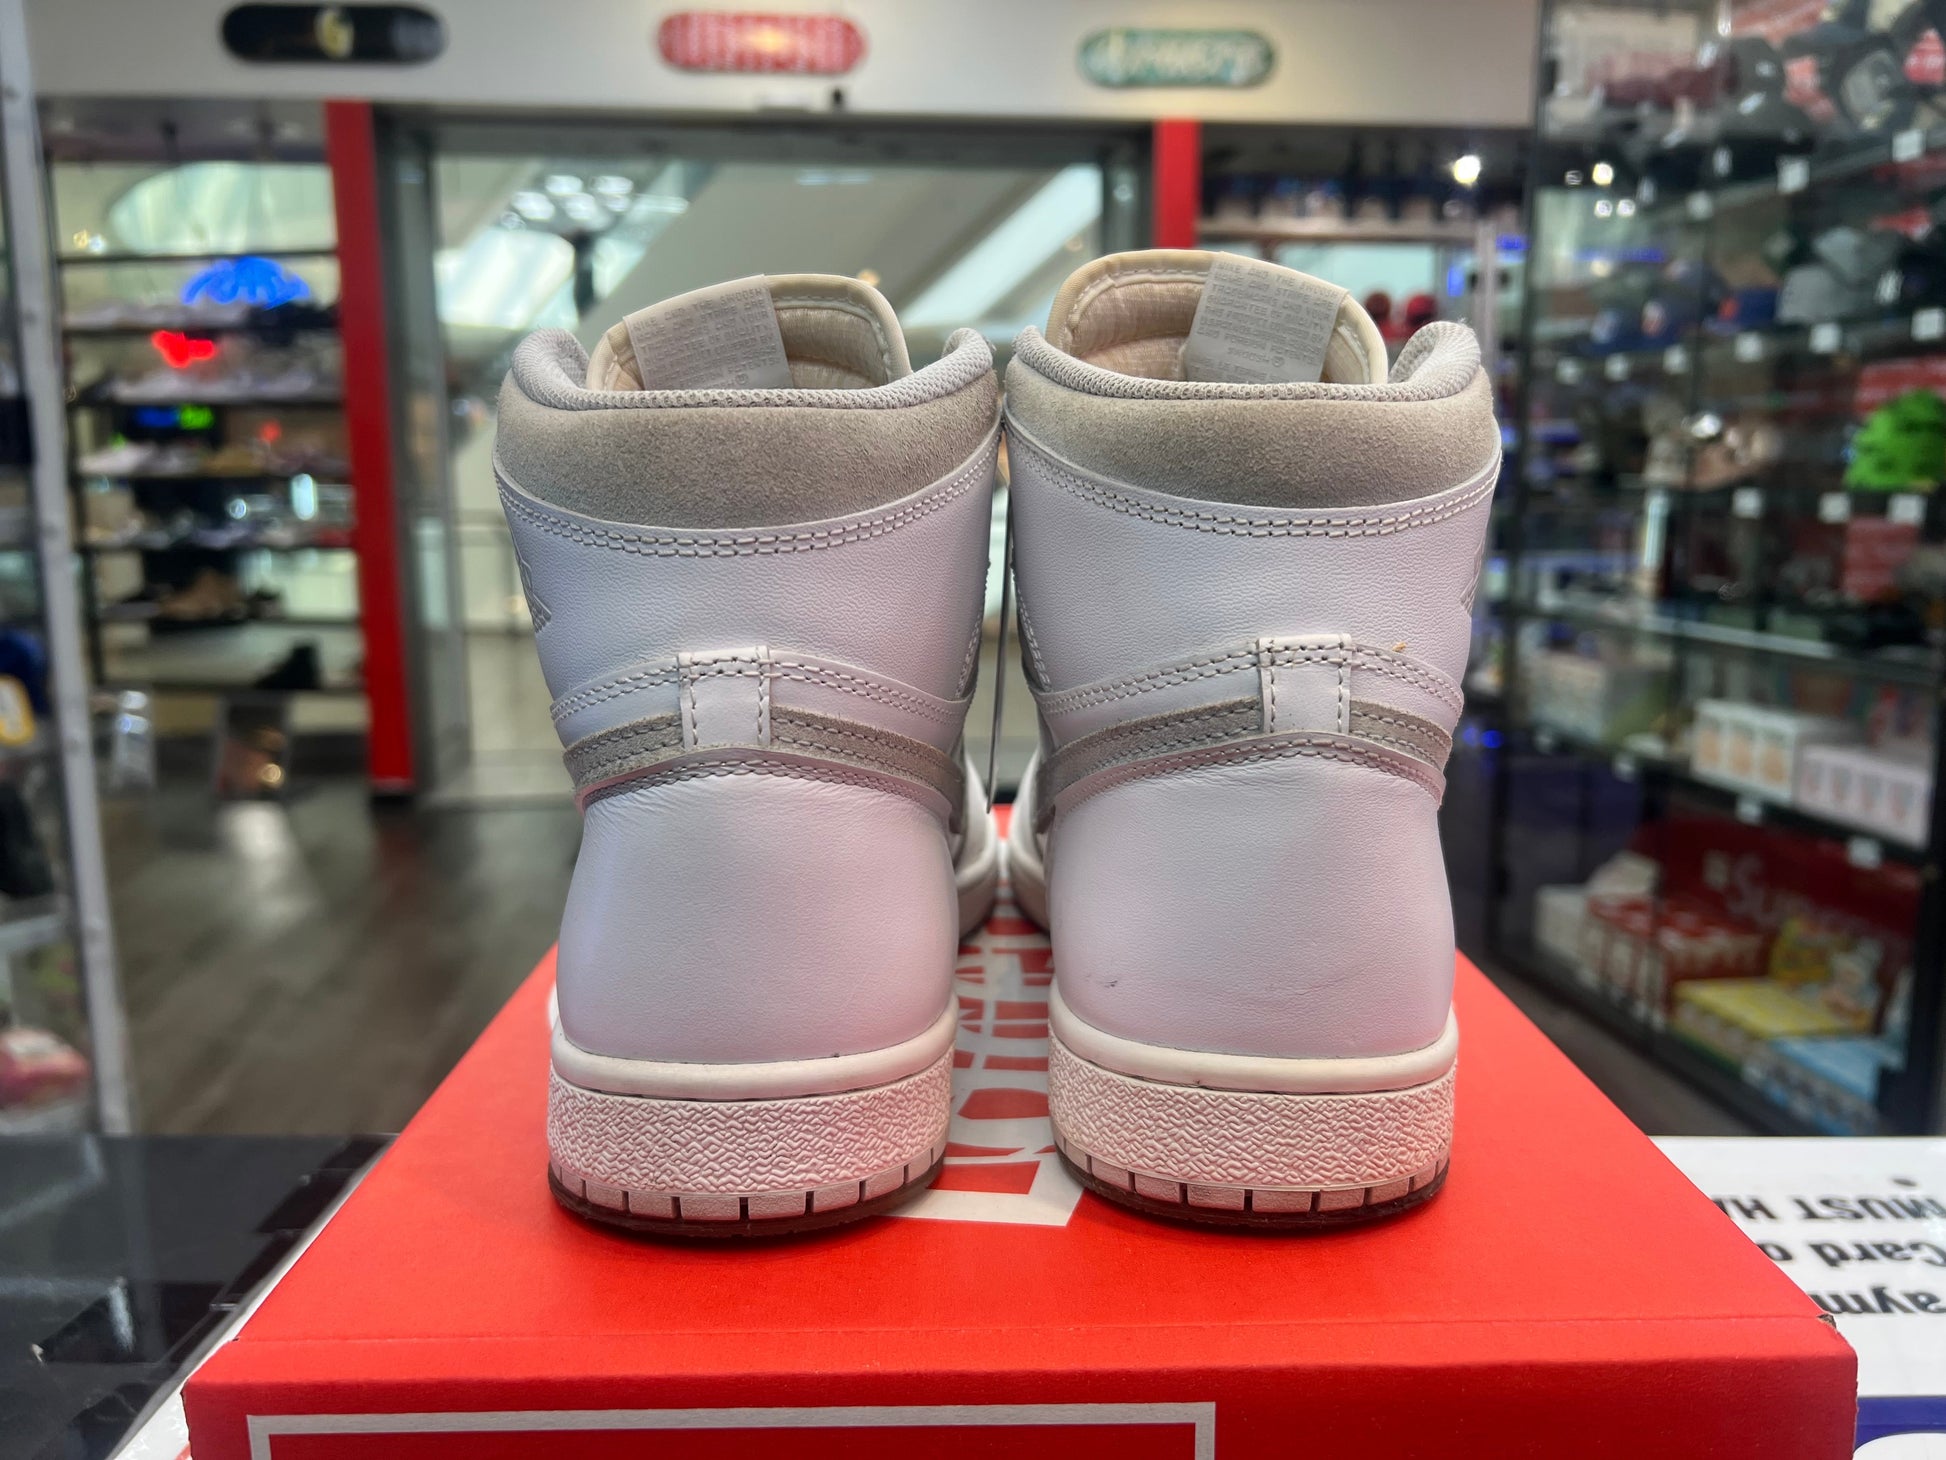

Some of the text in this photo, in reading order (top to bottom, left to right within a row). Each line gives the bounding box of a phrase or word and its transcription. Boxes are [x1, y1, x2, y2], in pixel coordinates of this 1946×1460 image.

[720, 287, 761, 303] SWOOSH
[740, 310, 767, 323] YOUR
[1793, 1198, 1946, 1219] MUST
[1807, 1242, 1946, 1267] Card
